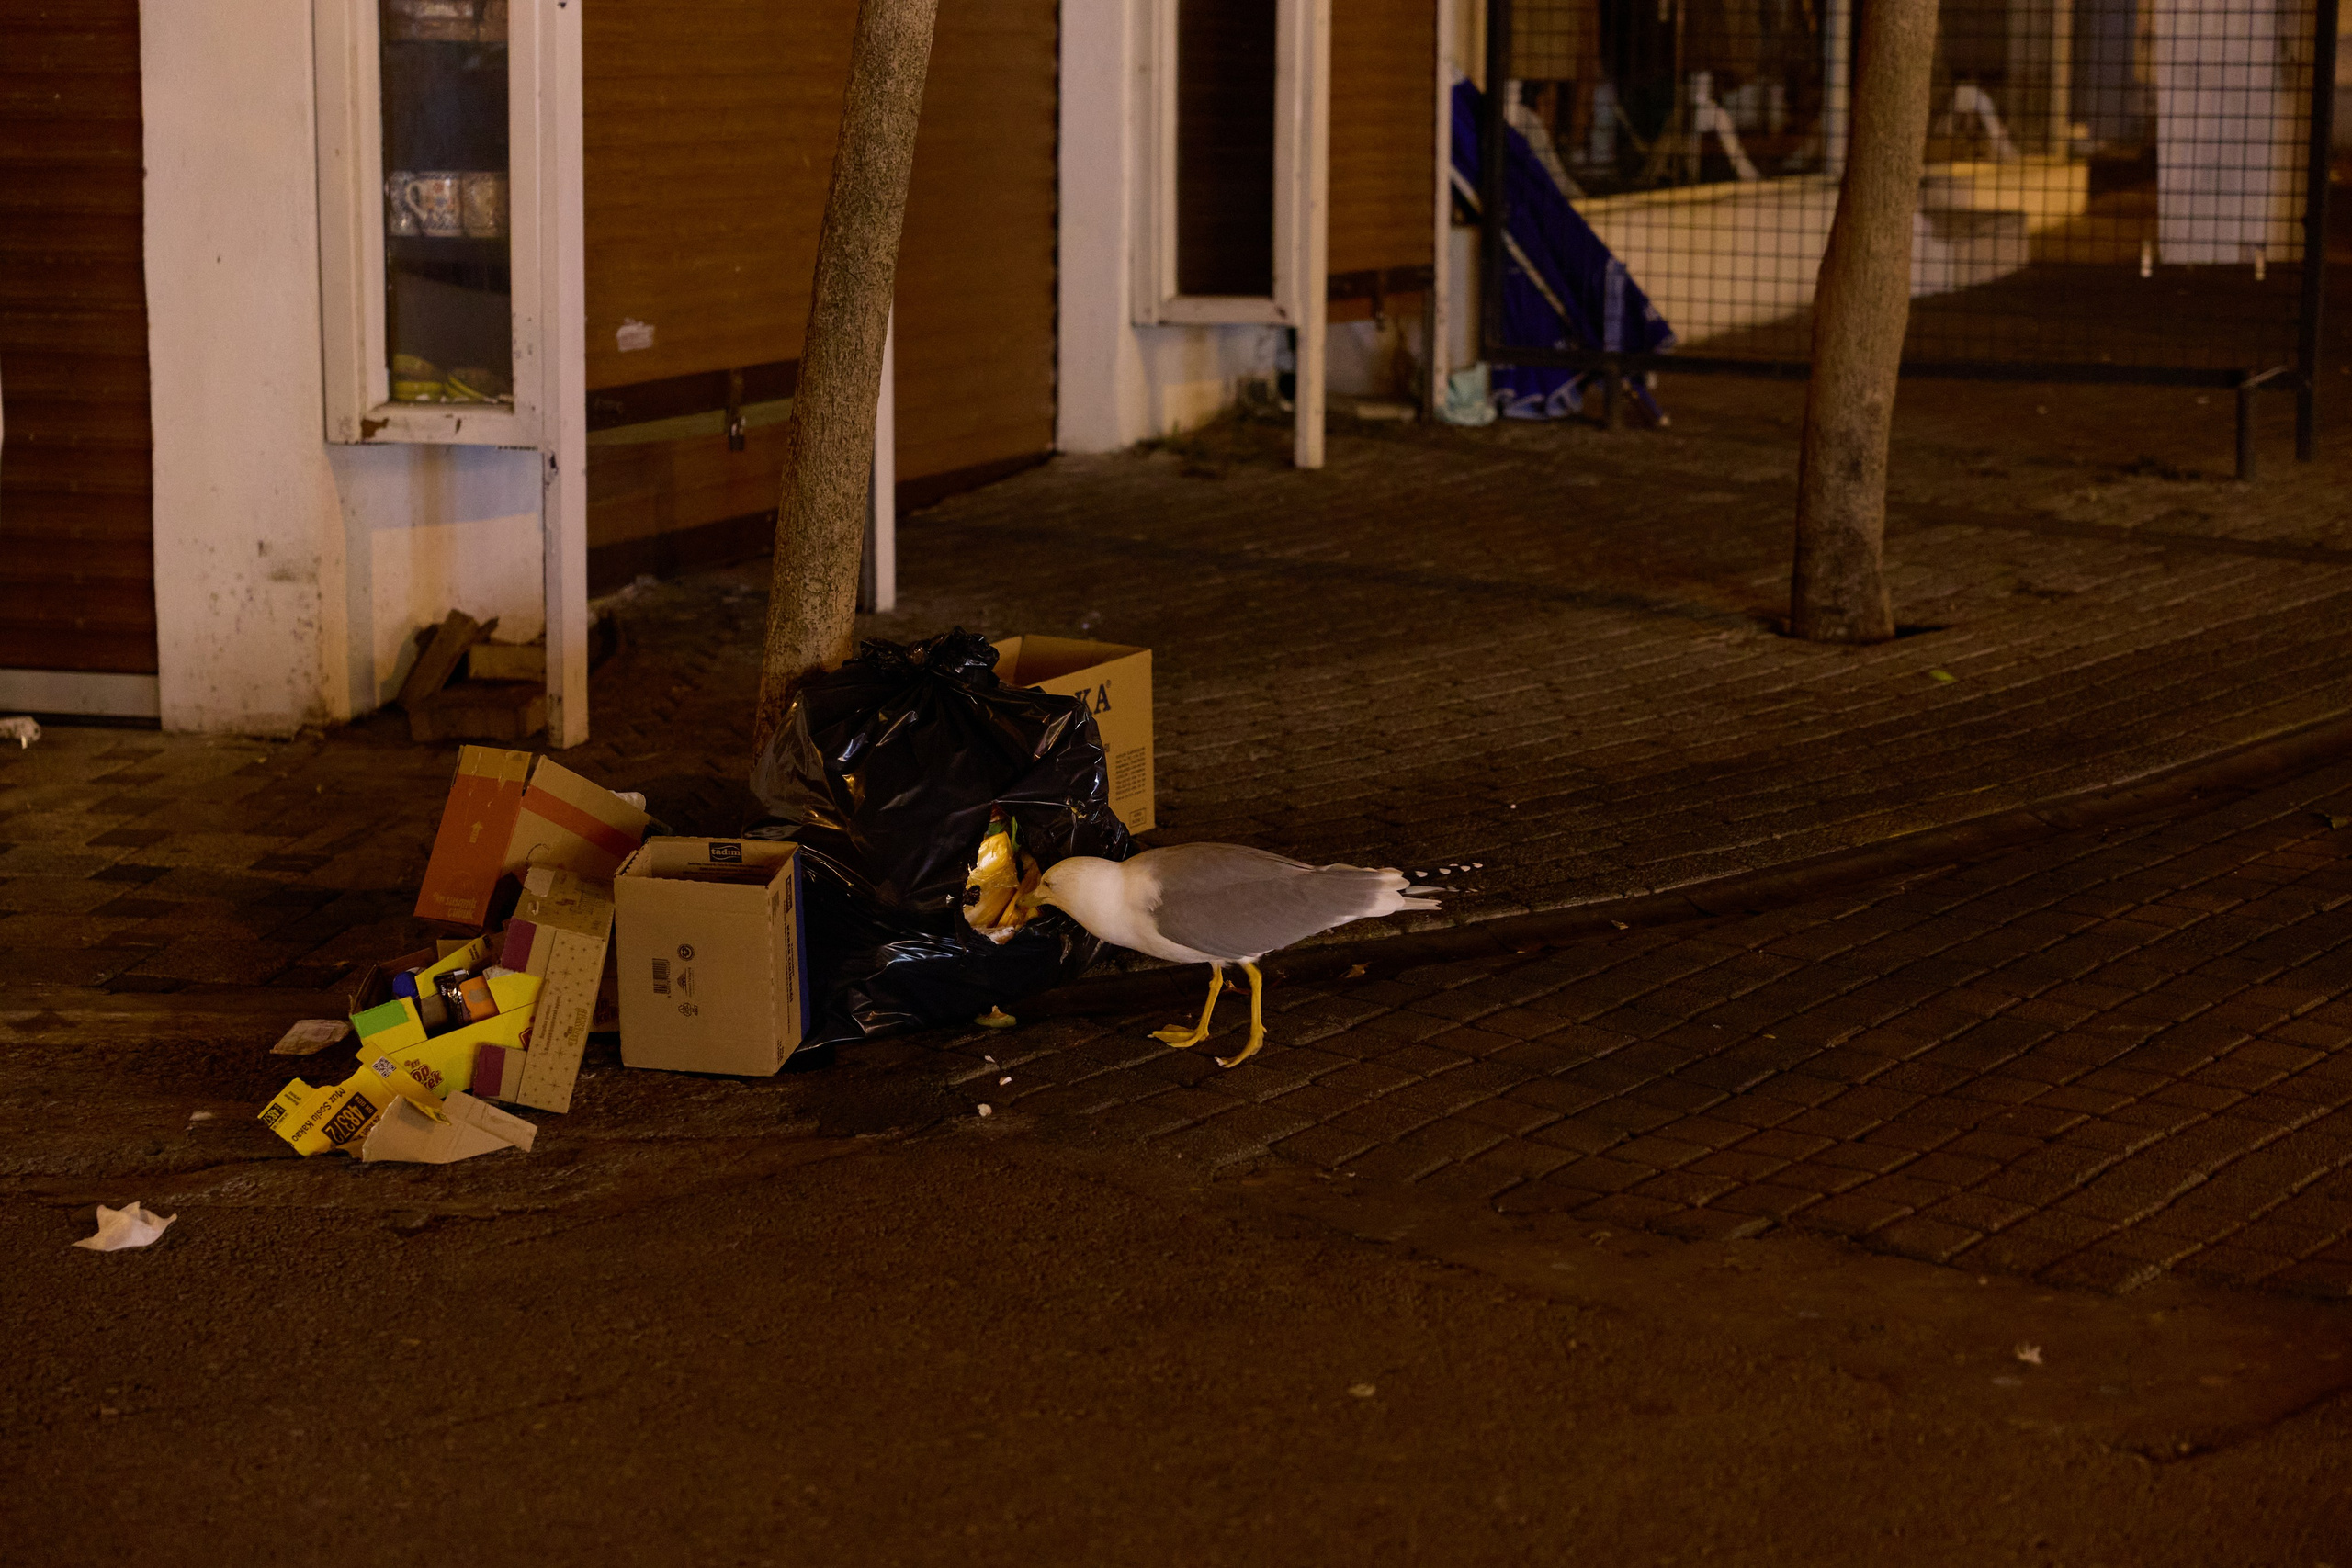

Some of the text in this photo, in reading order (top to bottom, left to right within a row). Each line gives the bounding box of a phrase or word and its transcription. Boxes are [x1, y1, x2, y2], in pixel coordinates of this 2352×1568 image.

[1075, 683, 1111, 715] KA
[711, 848, 741, 856] tadım
[291, 1088, 346, 1142] Muz Soslu Kakao
[325, 1105, 366, 1144] 48372
[365, 1105, 374, 1114] NO
